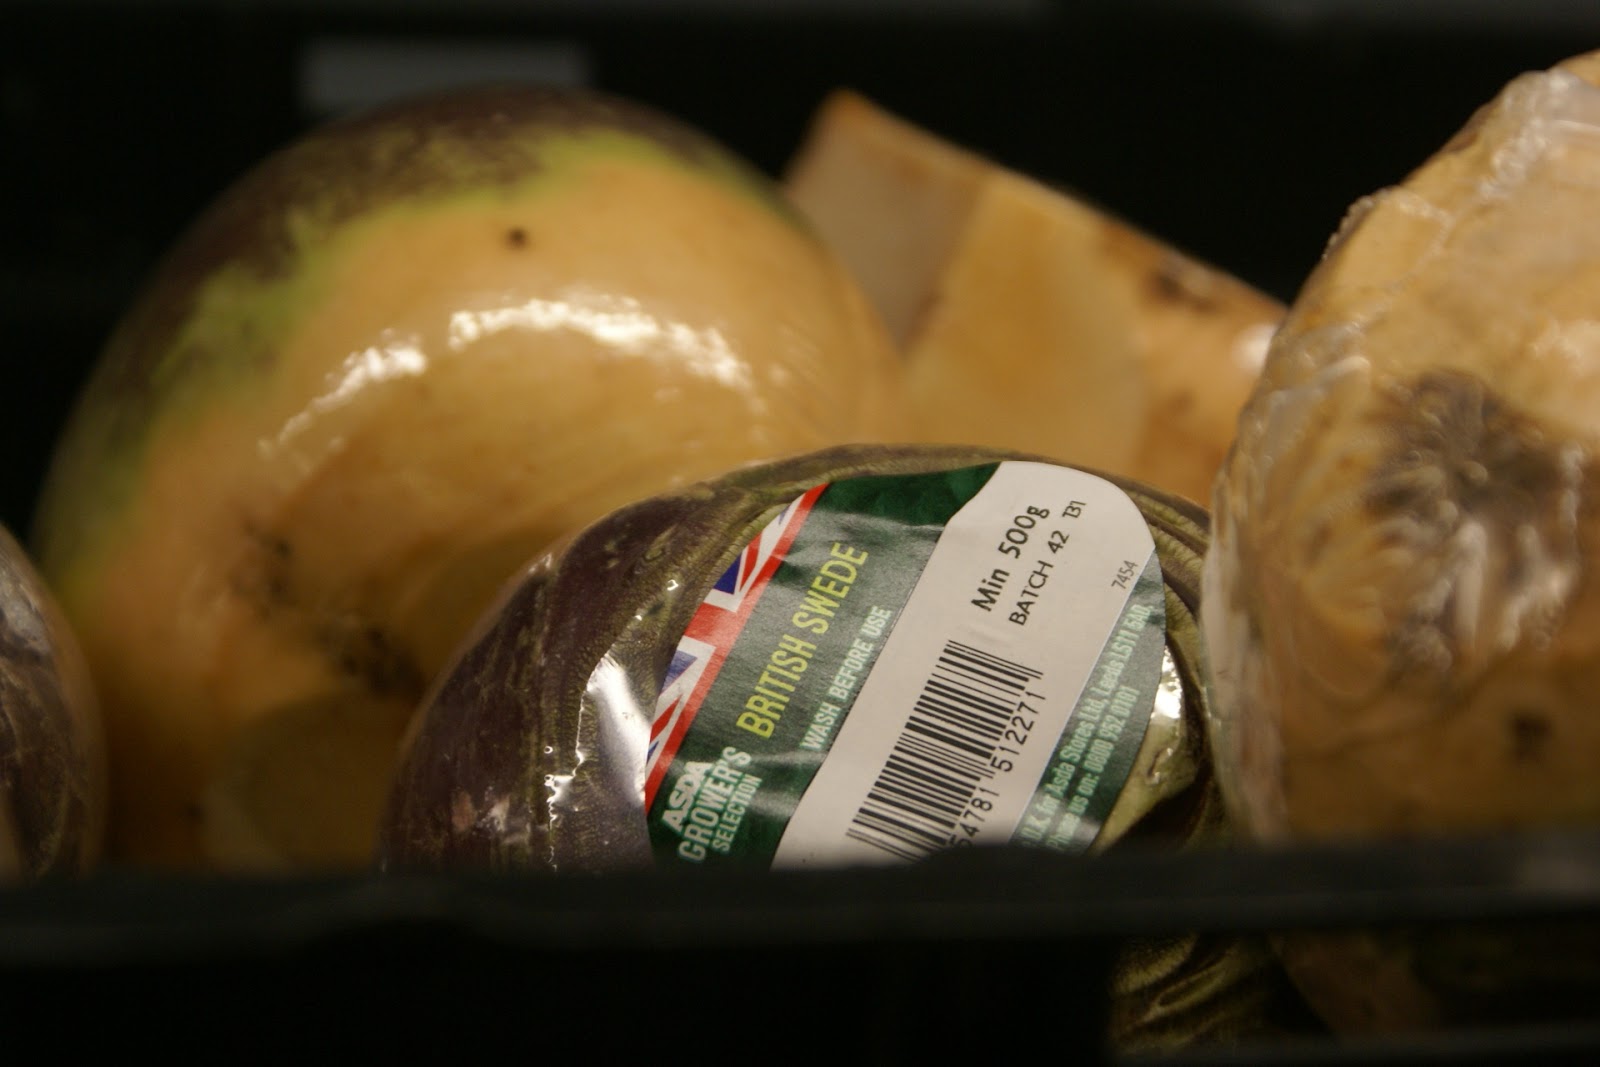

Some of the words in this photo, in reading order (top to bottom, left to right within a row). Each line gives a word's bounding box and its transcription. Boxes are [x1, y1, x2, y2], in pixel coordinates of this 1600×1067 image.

[971, 568, 1010, 612] Min
[998, 506, 1050, 559] 500g
[1008, 560, 1054, 626] BATCH
[1047, 530, 1070, 554] 42
[1111, 560, 1138, 589] 7454
[736, 634, 817, 739] BRITISH
[792, 542, 868, 634] SWEDE
[800, 701, 841, 750] WASH
[828, 638, 874, 700] BEFORE
[861, 605, 892, 637] USE
[991, 691, 1047, 773] 512271
[1044, 762, 1075, 799] Asda
[1060, 720, 1095, 763] Stores
[1089, 660, 1125, 697] Leeds
[1083, 738, 1115, 772] 0800
[1099, 714, 1127, 741] 952
[662, 761, 713, 832] ASDA
[678, 746, 752, 862] GROWER'S
[712, 774, 762, 851] SELECTION
[1068, 795, 1089, 815] us
[1077, 773, 1100, 797] on:
